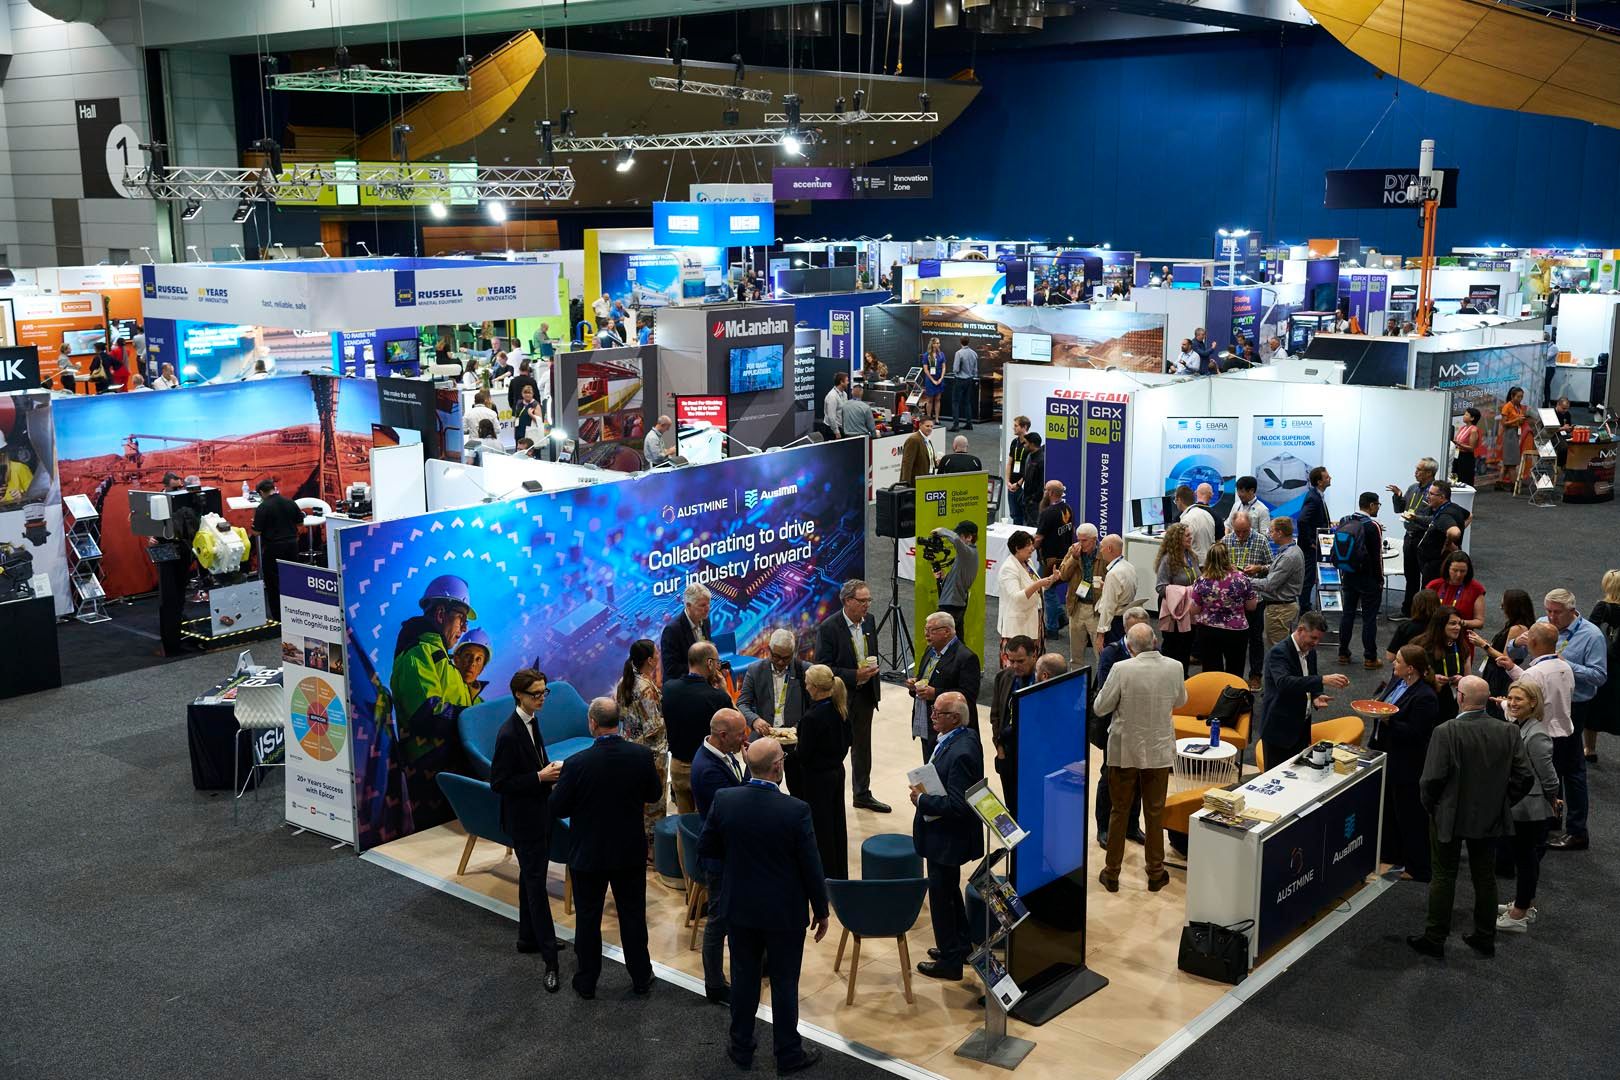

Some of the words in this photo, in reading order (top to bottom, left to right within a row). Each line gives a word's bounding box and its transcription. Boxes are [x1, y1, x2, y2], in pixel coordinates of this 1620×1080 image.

[79, 104, 97, 119] Hall
[116, 136, 129, 166] 1
[893, 174, 929, 182] Innovation
[893, 183, 911, 191] Zone
[1371, 275, 1386, 283] GRX
[157, 285, 188, 295] RUSSELL
[206, 287, 228, 297] YEARS
[418, 288, 463, 299] RUSSELL
[487, 285, 517, 295] YEARS
[833, 313, 850, 321] GRX
[724, 317, 789, 338] McLanahan
[832, 324, 844, 332] C12
[1438, 361, 1480, 378] MX3
[1050, 402, 1080, 416] GRX
[1091, 406, 1122, 419] GRX
[1048, 422, 1065, 433] B06
[1069, 415, 1079, 438] 25
[1089, 426, 1107, 437] B04
[1111, 419, 1122, 442] 25
[1100, 453, 1110, 486] EBARA
[925, 491, 946, 501] GRX
[677, 498, 728, 518] AUSTMINE
[951, 507, 965, 515] Expo
[1099, 488, 1109, 538] HAYWARD
[648, 533, 755, 571] Collaborating
[759, 528, 775, 545] to
[779, 519, 815, 540] drive
[653, 577, 681, 596] our
[685, 559, 750, 588] industry
[754, 541, 812, 571] forward
[284, 606, 311, 617] Transform
[290, 617, 303, 625] with
[303, 619, 329, 631] Cognitive
[296, 774, 307, 783] 20+
[307, 777, 322, 788] Years
[322, 782, 344, 795] Success
[305, 786, 319, 795] with
[318, 789, 335, 801] Epicor
[1276, 869, 1314, 904] AUSTMINE
